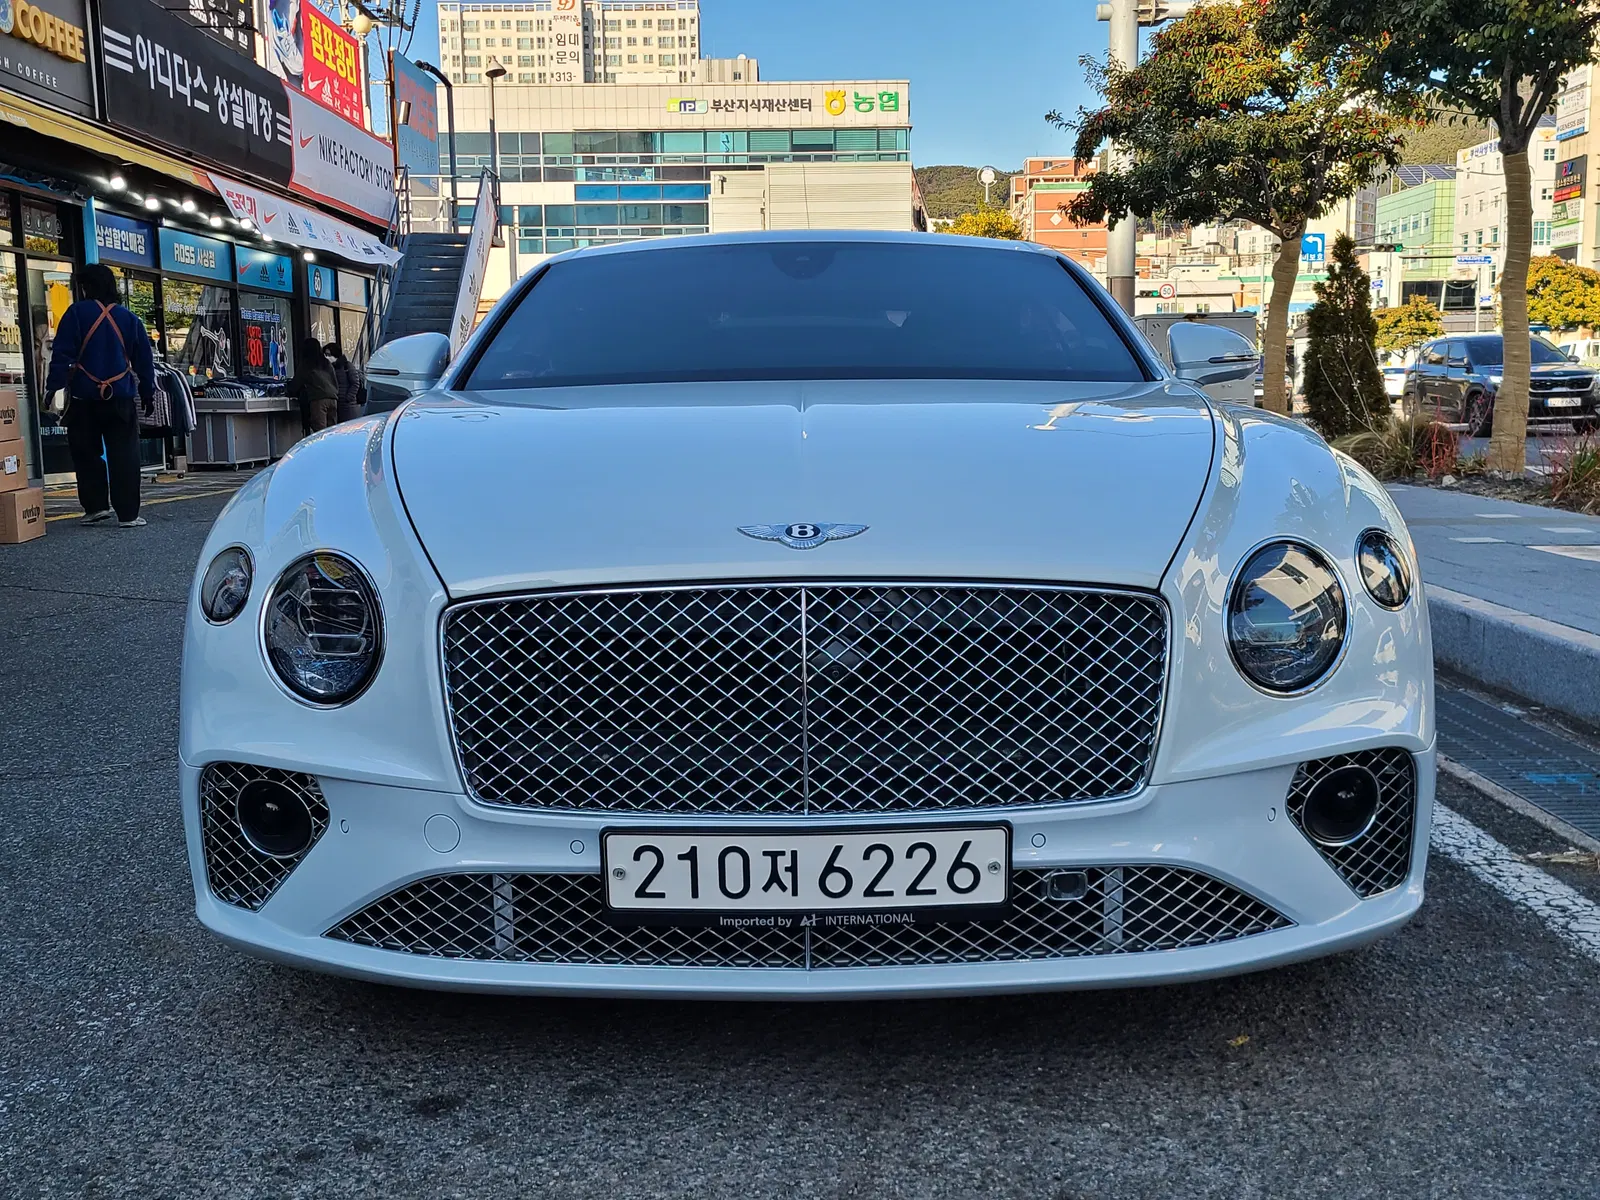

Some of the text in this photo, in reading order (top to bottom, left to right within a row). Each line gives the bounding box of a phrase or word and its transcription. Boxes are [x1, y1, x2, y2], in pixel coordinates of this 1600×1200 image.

[16, 0, 86, 63] COFFEE
[556, 33, 579, 46] 임대
[308, 13, 357, 87] 점포정리
[556, 51, 580, 64] 문의
[17, 62, 57, 88] COFFEE
[135, 34, 273, 142] 아디다스 상설매장
[710, 98, 812, 113] 부산지식재산센터
[853, 91, 900, 113] 농협
[318, 133, 338, 167] NIKE
[339, 144, 375, 185] FACTORY
[96, 225, 145, 255] 상설할인매장
[173, 242, 196, 265] ROSS
[1302, 253, 1324, 261] 비보호
[248, 338, 263, 367] 80
[633, 840, 981, 899] 210저 6226
[720, 916, 774, 927] Imported
[778, 916, 792, 928] by
[825, 914, 916, 926] INTERNATIONAL
